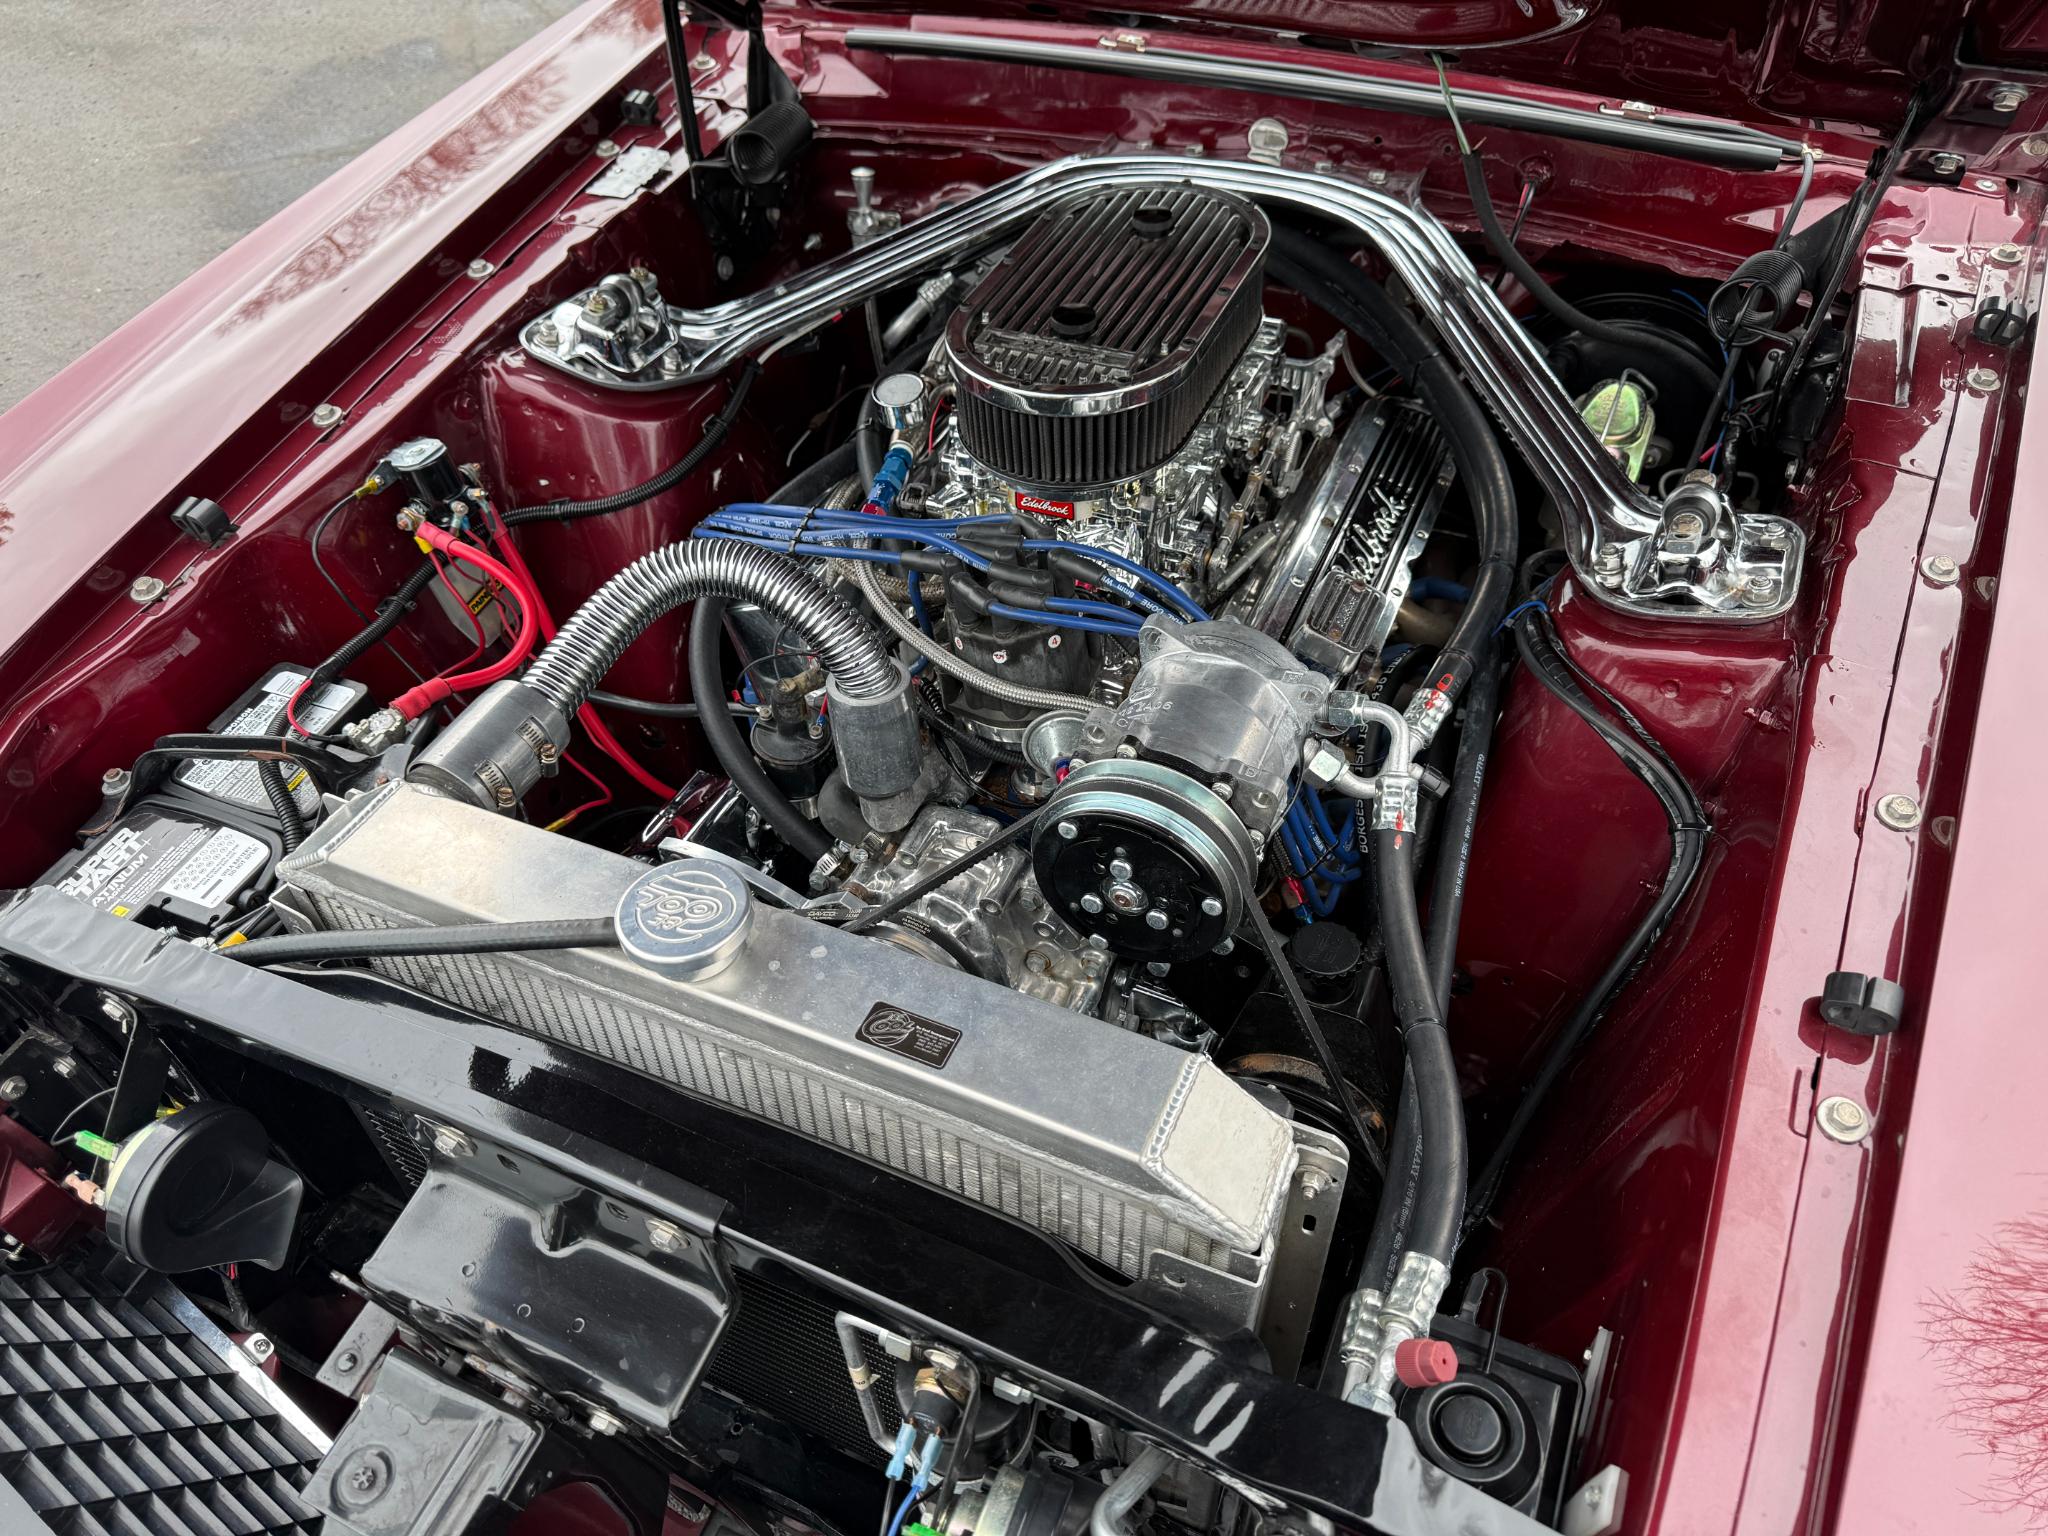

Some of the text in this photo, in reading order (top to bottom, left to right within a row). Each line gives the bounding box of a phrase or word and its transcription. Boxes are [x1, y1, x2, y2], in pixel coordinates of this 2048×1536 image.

[1020, 496, 1070, 516] Edelbrock
[1472, 752, 1485, 786] GALAXY
[66, 831, 143, 897] TART
[92, 853, 149, 907] ATINUM
[1453, 884, 1462, 897] USA
